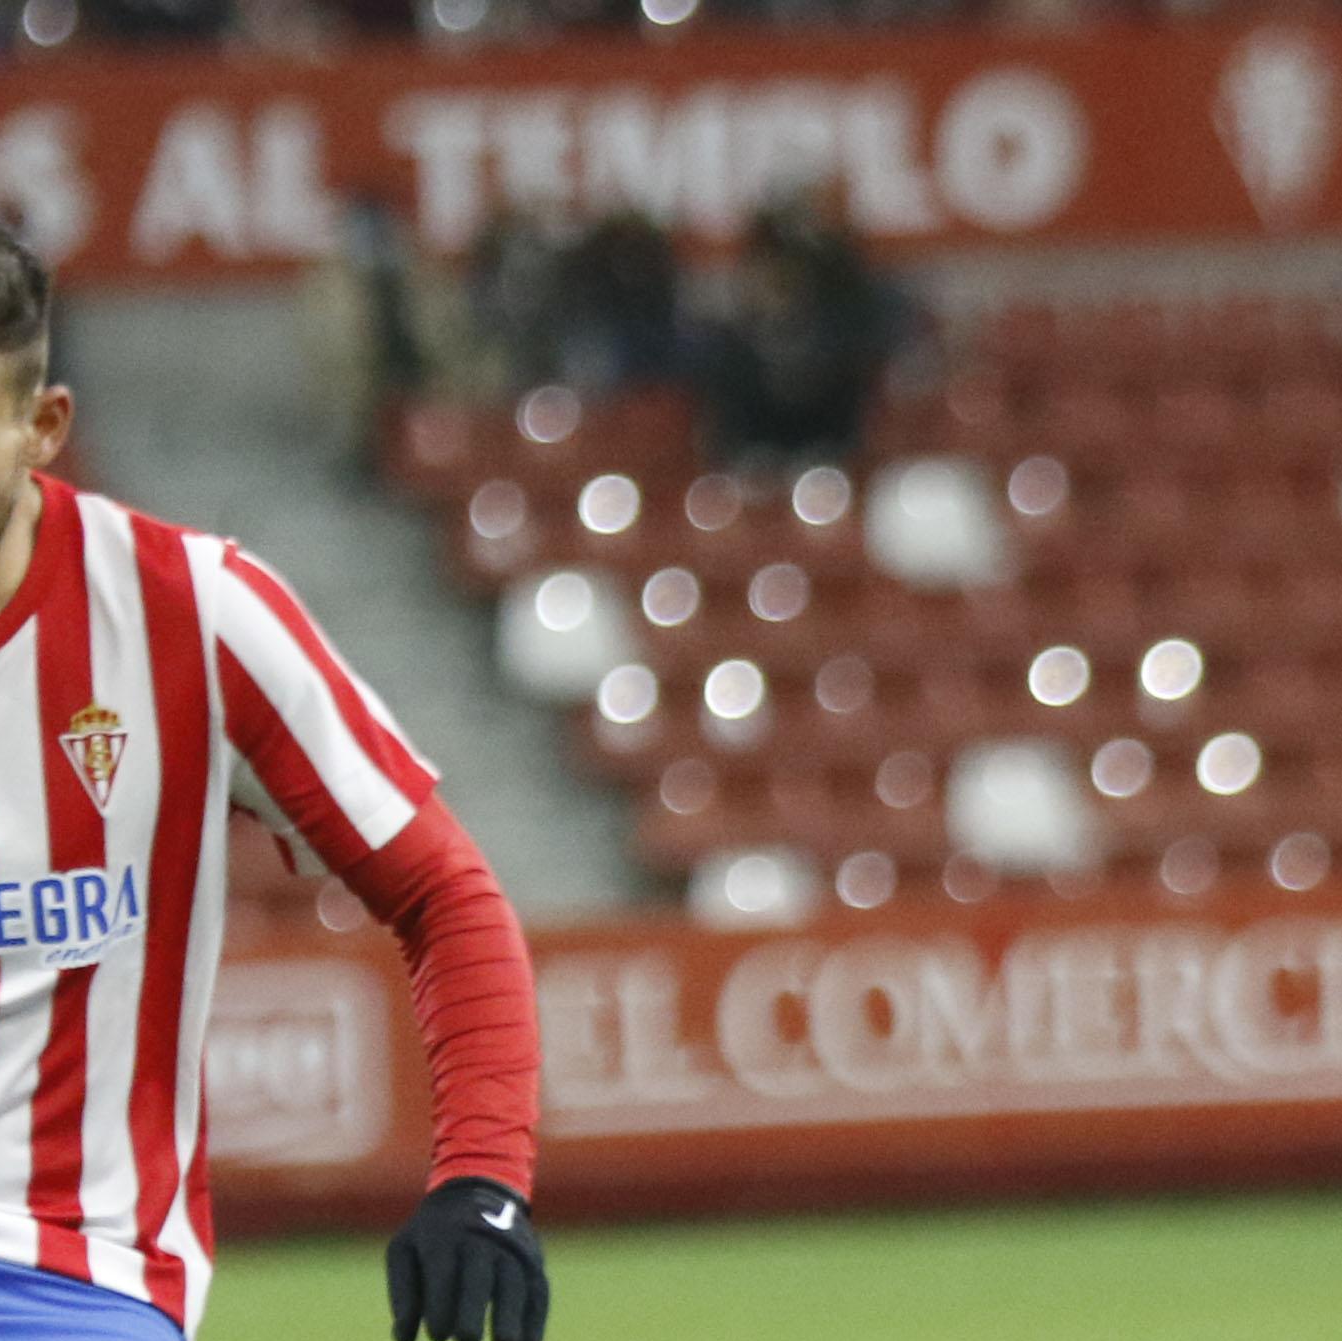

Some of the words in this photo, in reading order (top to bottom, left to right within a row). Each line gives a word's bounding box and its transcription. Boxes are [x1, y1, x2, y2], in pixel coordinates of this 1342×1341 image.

[129, 102, 335, 266] AL
[381, 64, 1089, 254] TEMPLO
[538, 944, 713, 1106] EL
